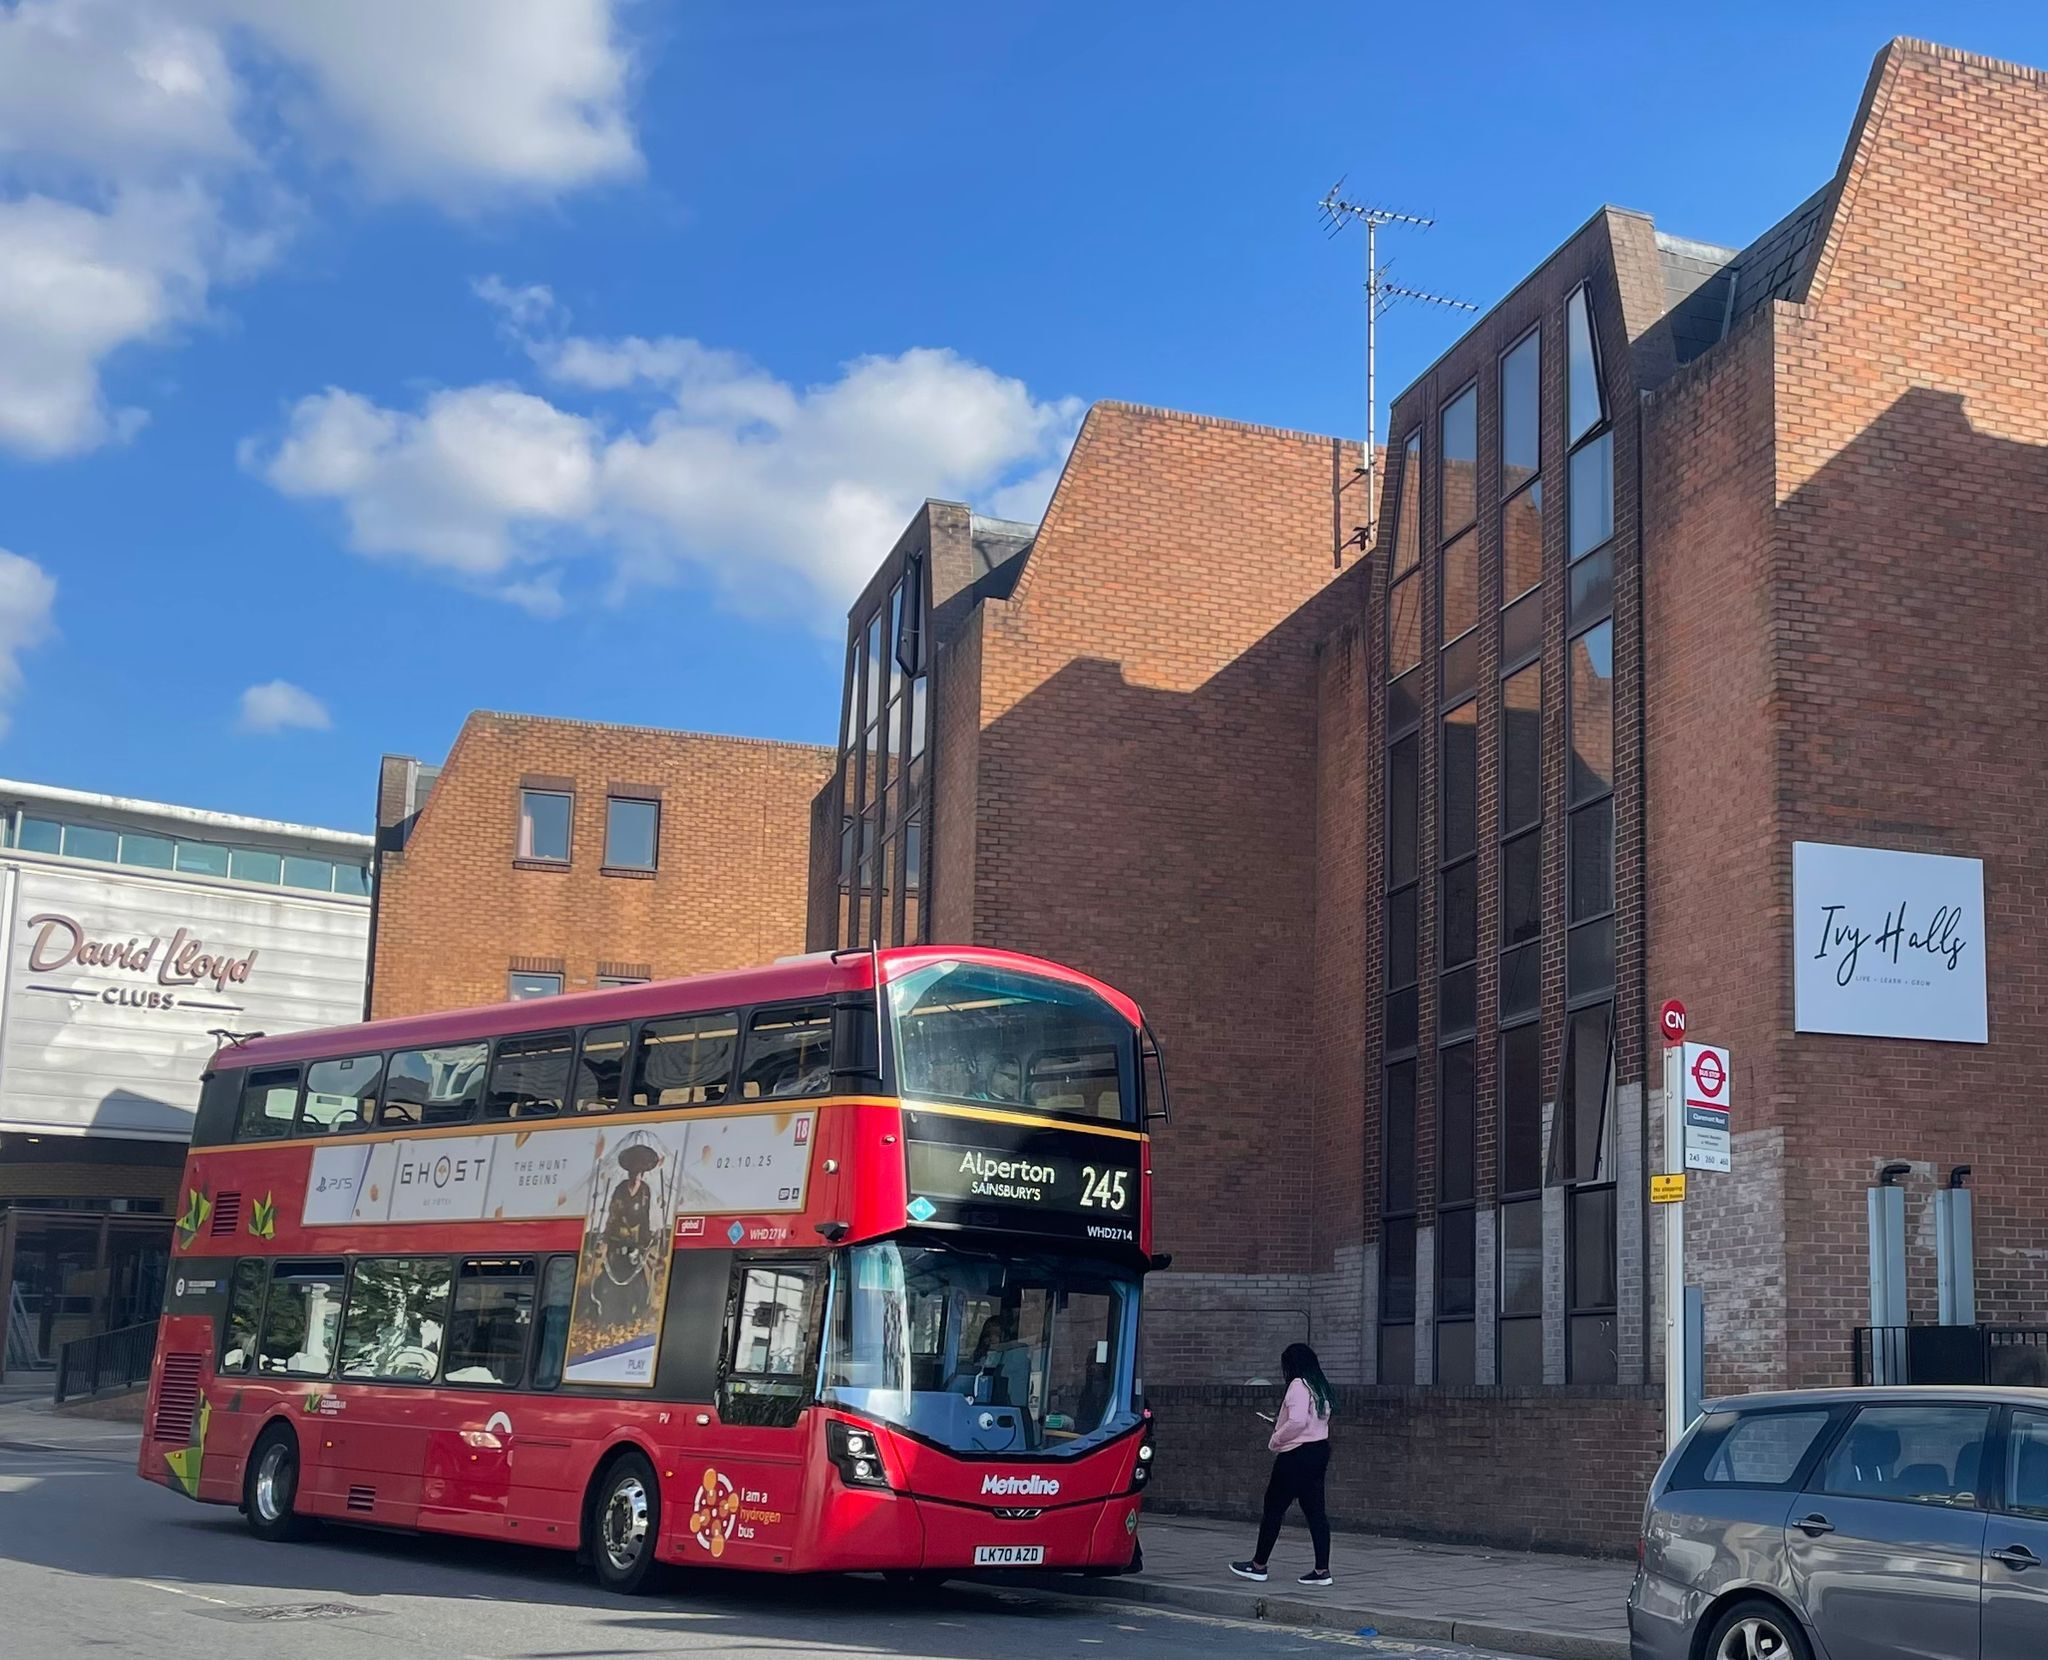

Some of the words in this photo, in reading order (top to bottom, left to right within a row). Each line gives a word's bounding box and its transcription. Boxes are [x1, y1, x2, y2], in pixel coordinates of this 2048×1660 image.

[1814, 905, 1872, 987] Ivy
[1875, 901, 1967, 971] Halls
[28, 913, 160, 973] David
[158, 927, 259, 992] Lloyd
[102, 987, 175, 1010] CLUBS
[1665, 1010, 1686, 1030] CN
[797, 1120, 808, 1139] 18
[514, 1161, 533, 1172] THE
[539, 1158, 568, 1170] HUNT
[716, 1155, 772, 1168] 02.10.25
[959, 1151, 1055, 1183] Alperton
[400, 1156, 485, 1188] GHOST
[518, 1173, 558, 1186] BEGINS
[328, 1177, 353, 1189] PS5
[971, 1181, 1041, 1201] SAINSBURY'S
[1080, 1166, 1127, 1210] 245
[750, 1228, 787, 1240] WHD2714
[1087, 1225, 1133, 1241] WHD2714
[627, 1359, 645, 1369] PLAY
[981, 1474, 1059, 1495] Metroline
[746, 1490, 760, 1502] am
[761, 1493, 768, 1503] a
[740, 1508, 781, 1524] hydrogen
[738, 1524, 754, 1538] bus
[980, 1548, 1012, 1561] LK70
[1015, 1548, 1038, 1561] AZD
